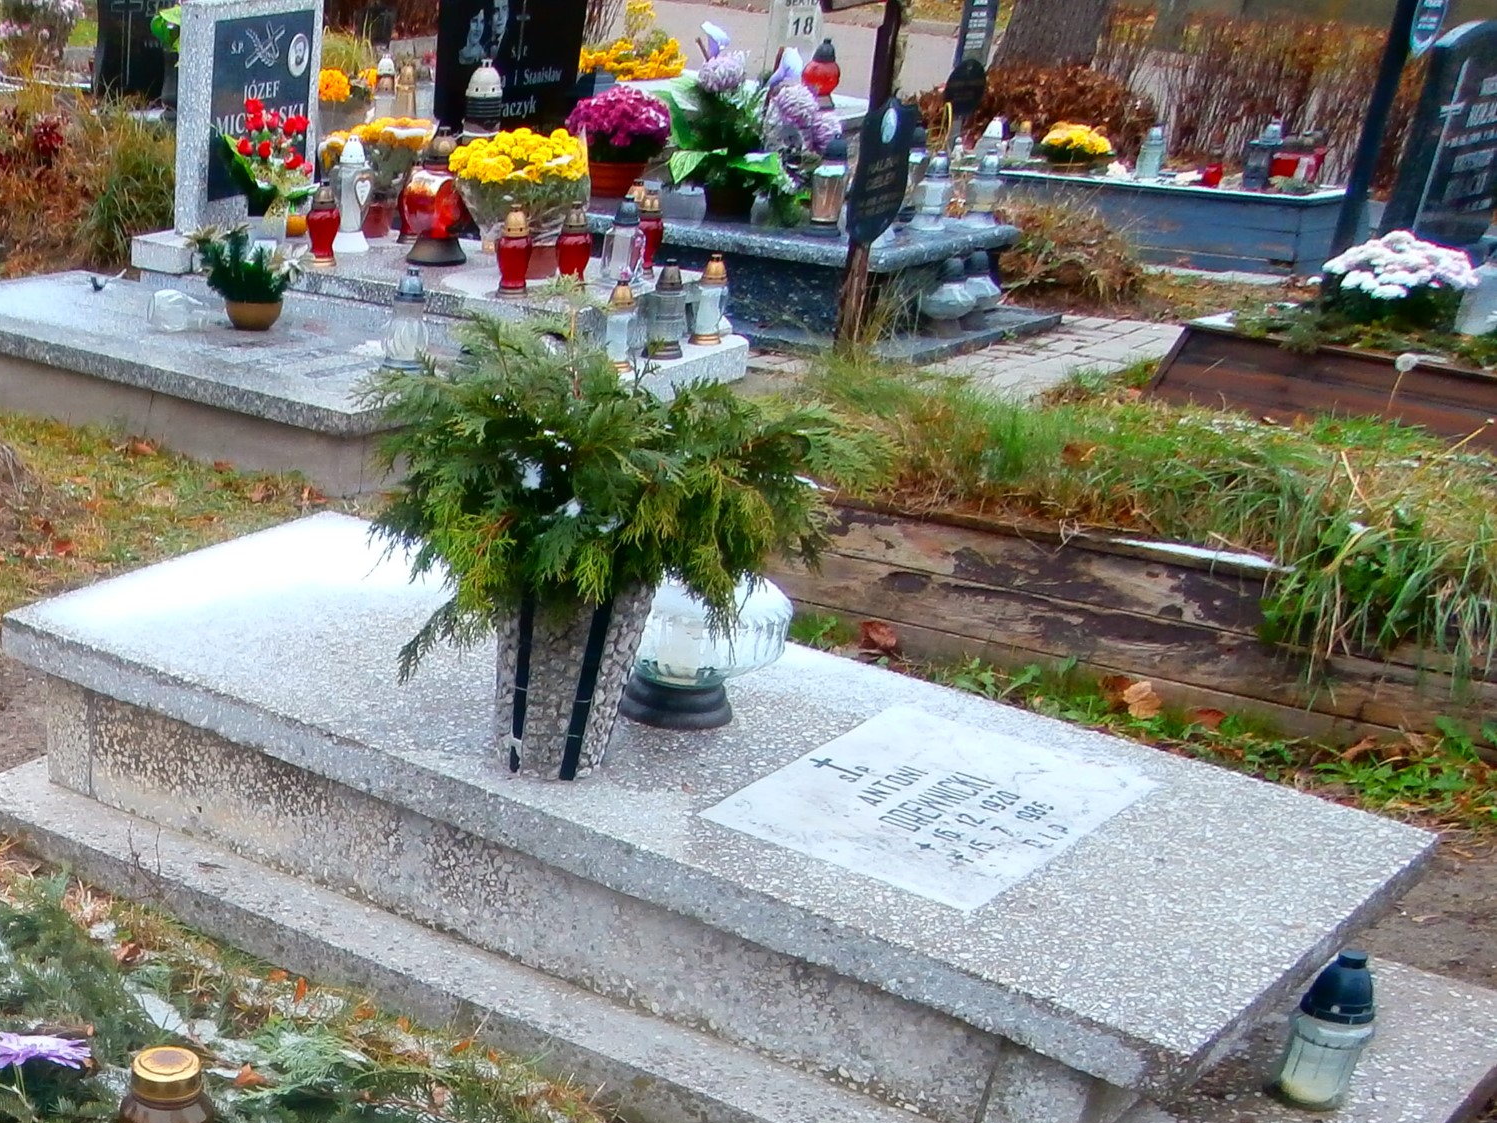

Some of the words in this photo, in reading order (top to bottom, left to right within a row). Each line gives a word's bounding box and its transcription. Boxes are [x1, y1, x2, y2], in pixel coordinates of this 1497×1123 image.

[792, 16, 814, 36] 18
[243, 79, 281, 105] JÓZEF
[501, 95, 537, 119] aczyk
[215, 104, 305, 137] MICSKI
[857, 765, 929, 807] ANTONI
[878, 771, 996, 832] DREWNICKI
[979, 790, 1021, 814] 1920
